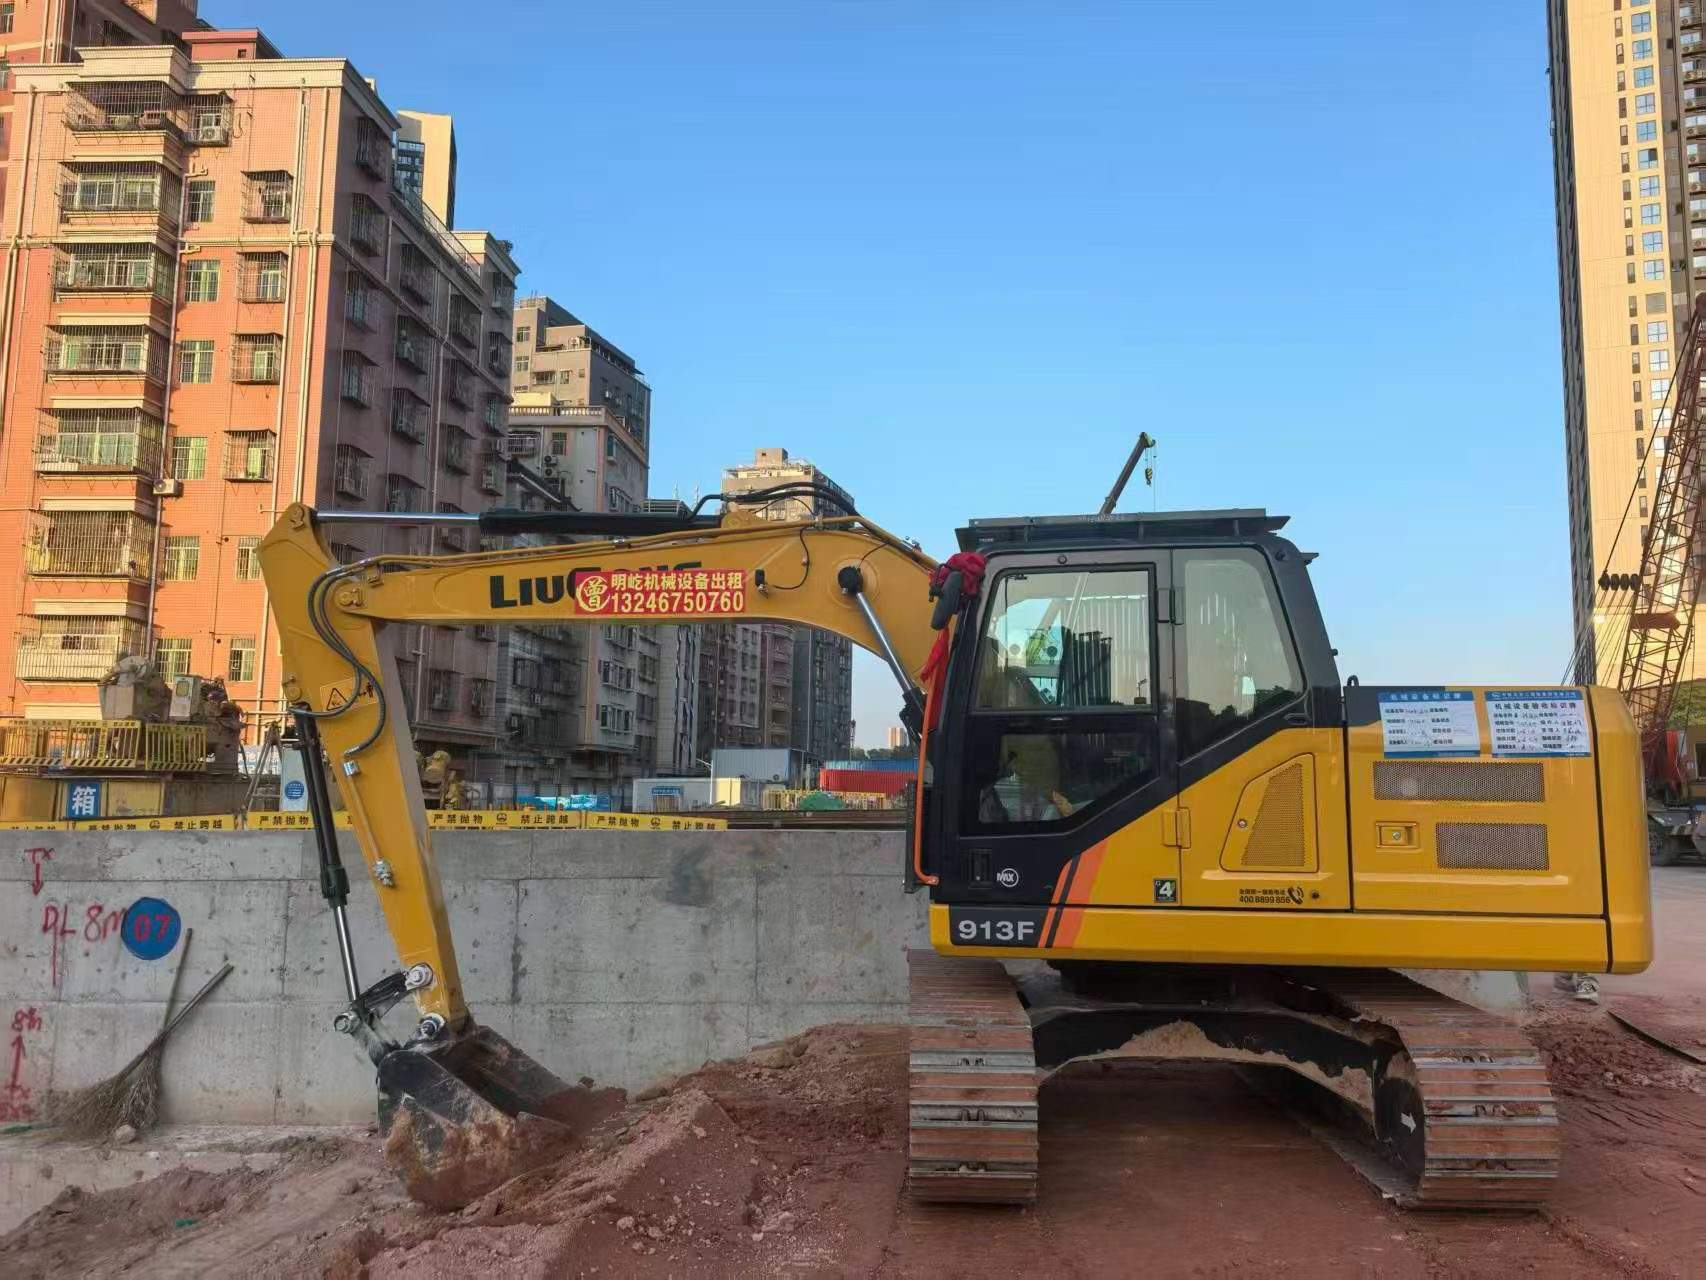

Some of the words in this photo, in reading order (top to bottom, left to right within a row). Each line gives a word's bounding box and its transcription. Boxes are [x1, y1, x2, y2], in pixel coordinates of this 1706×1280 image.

[611, 572, 744, 591] 明屹机械设备出租
[611, 592, 744, 613] 13246750760
[72, 786, 97, 815] 箱
[433, 813, 483, 825] 严禁抛物
[520, 814, 569, 825] 禁止跨越
[134, 914, 171, 942] 07
[958, 919, 1035, 940] 913F
